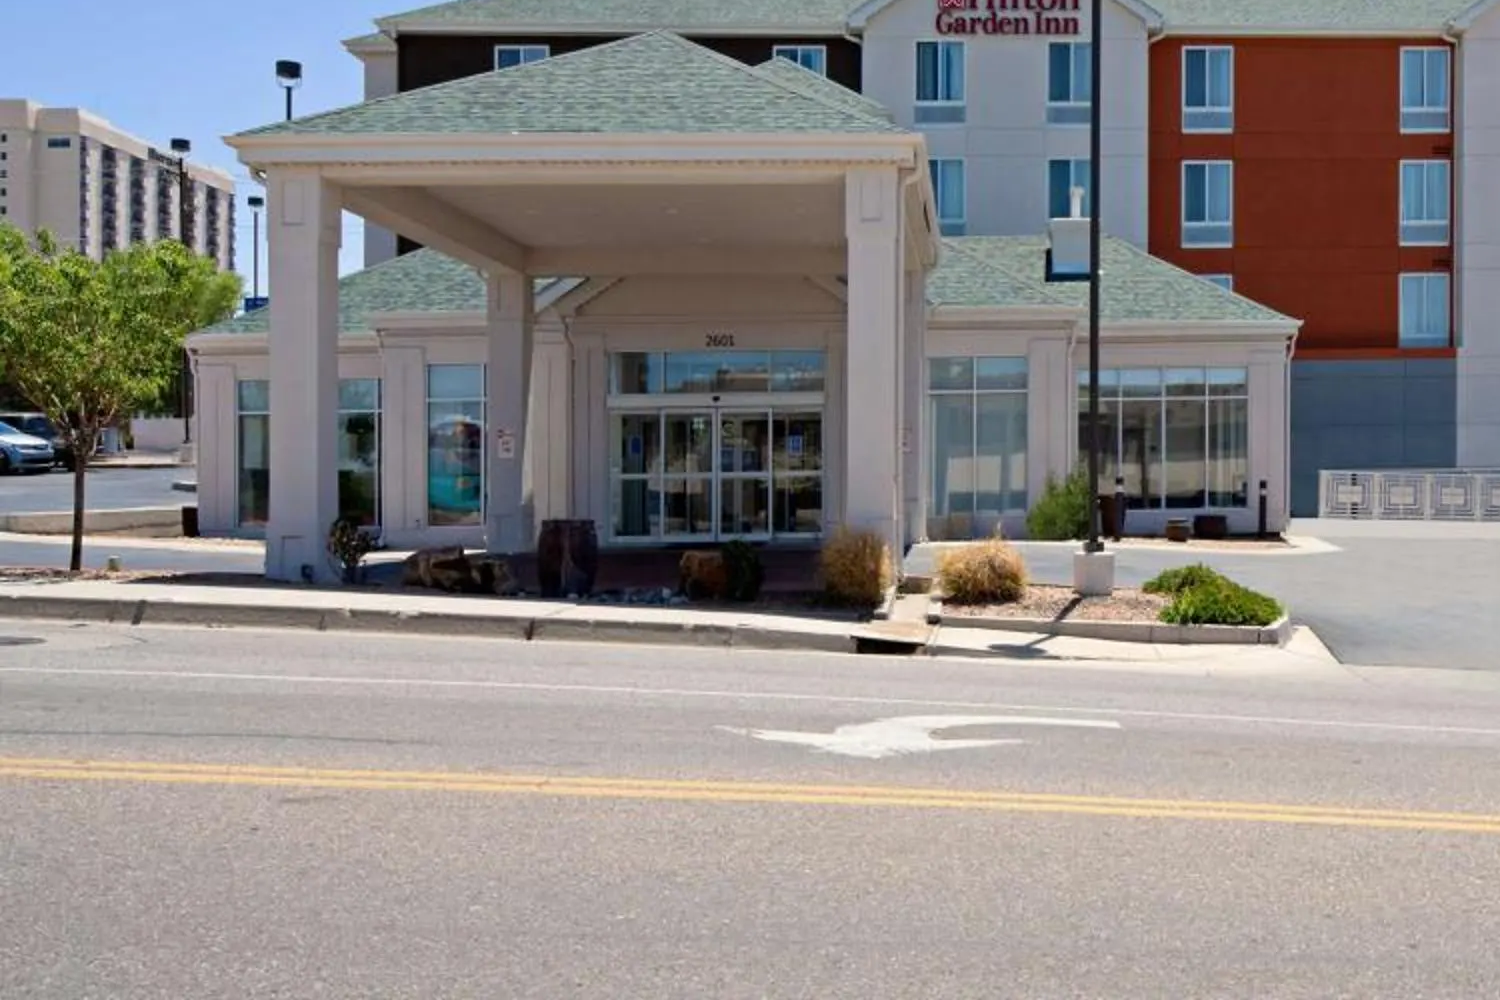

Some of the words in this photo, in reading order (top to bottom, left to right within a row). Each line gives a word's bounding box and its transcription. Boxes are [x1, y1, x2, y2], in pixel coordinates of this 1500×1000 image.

[936, 11, 1030, 35] Garden
[1035, 12, 1079, 35] Inn
[705, 333, 735, 348] 2601
